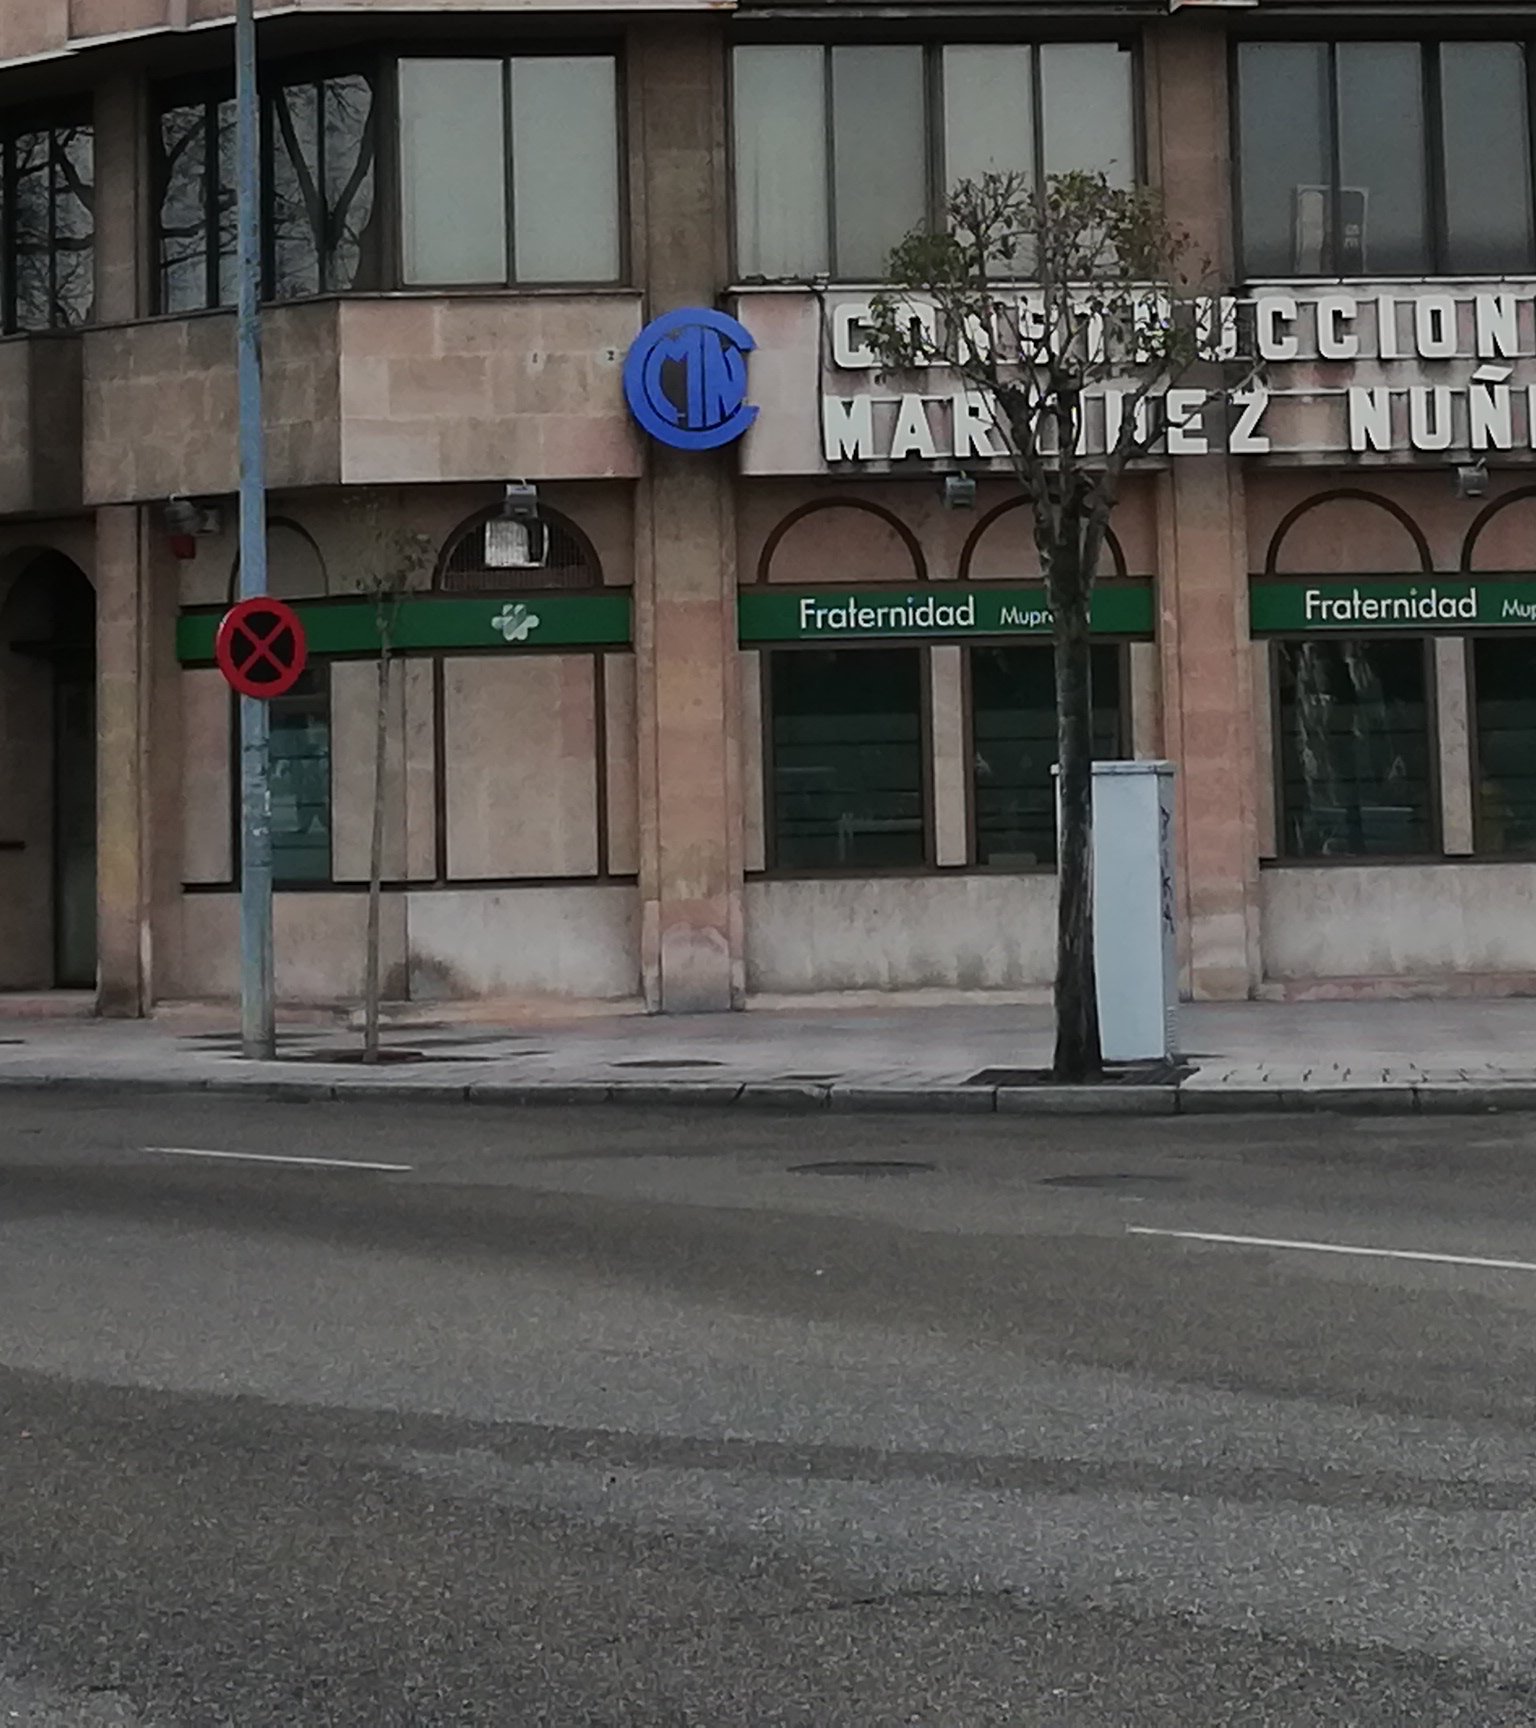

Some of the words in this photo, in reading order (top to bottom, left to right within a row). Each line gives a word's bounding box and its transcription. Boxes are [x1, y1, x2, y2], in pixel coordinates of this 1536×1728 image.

[825, 387, 1270, 462] MARINEZ
[800, 595, 975, 629] Fraternidad
[1305, 588, 1476, 619] Fraternidad
